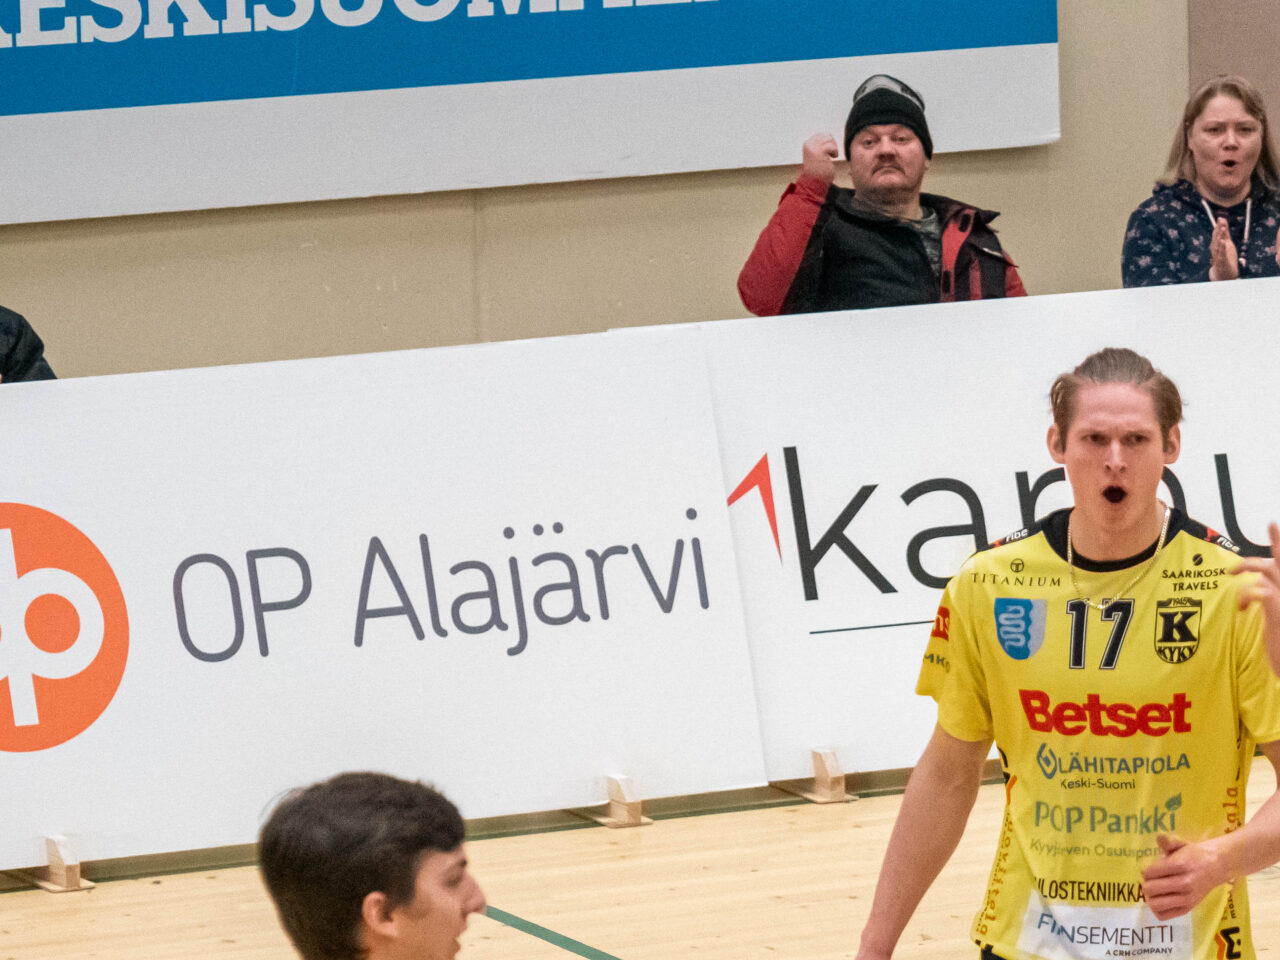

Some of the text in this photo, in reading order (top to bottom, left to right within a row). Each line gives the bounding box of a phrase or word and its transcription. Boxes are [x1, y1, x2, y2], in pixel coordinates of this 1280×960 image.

[971, 572, 1061, 588] TITANIUM
[1162, 567, 1227, 580] SAARIKOSK
[172, 508, 710, 663] OP Alajärvi
[1173, 580, 1219, 592] TRAVELS
[1066, 598, 1136, 671] 17
[1019, 688, 1192, 738] Betset
[1057, 752, 1191, 775] LÄHITAPIOLA
[1060, 778, 1136, 790] Keski-Suomi
[1035, 800, 1177, 834] POP Pankki
